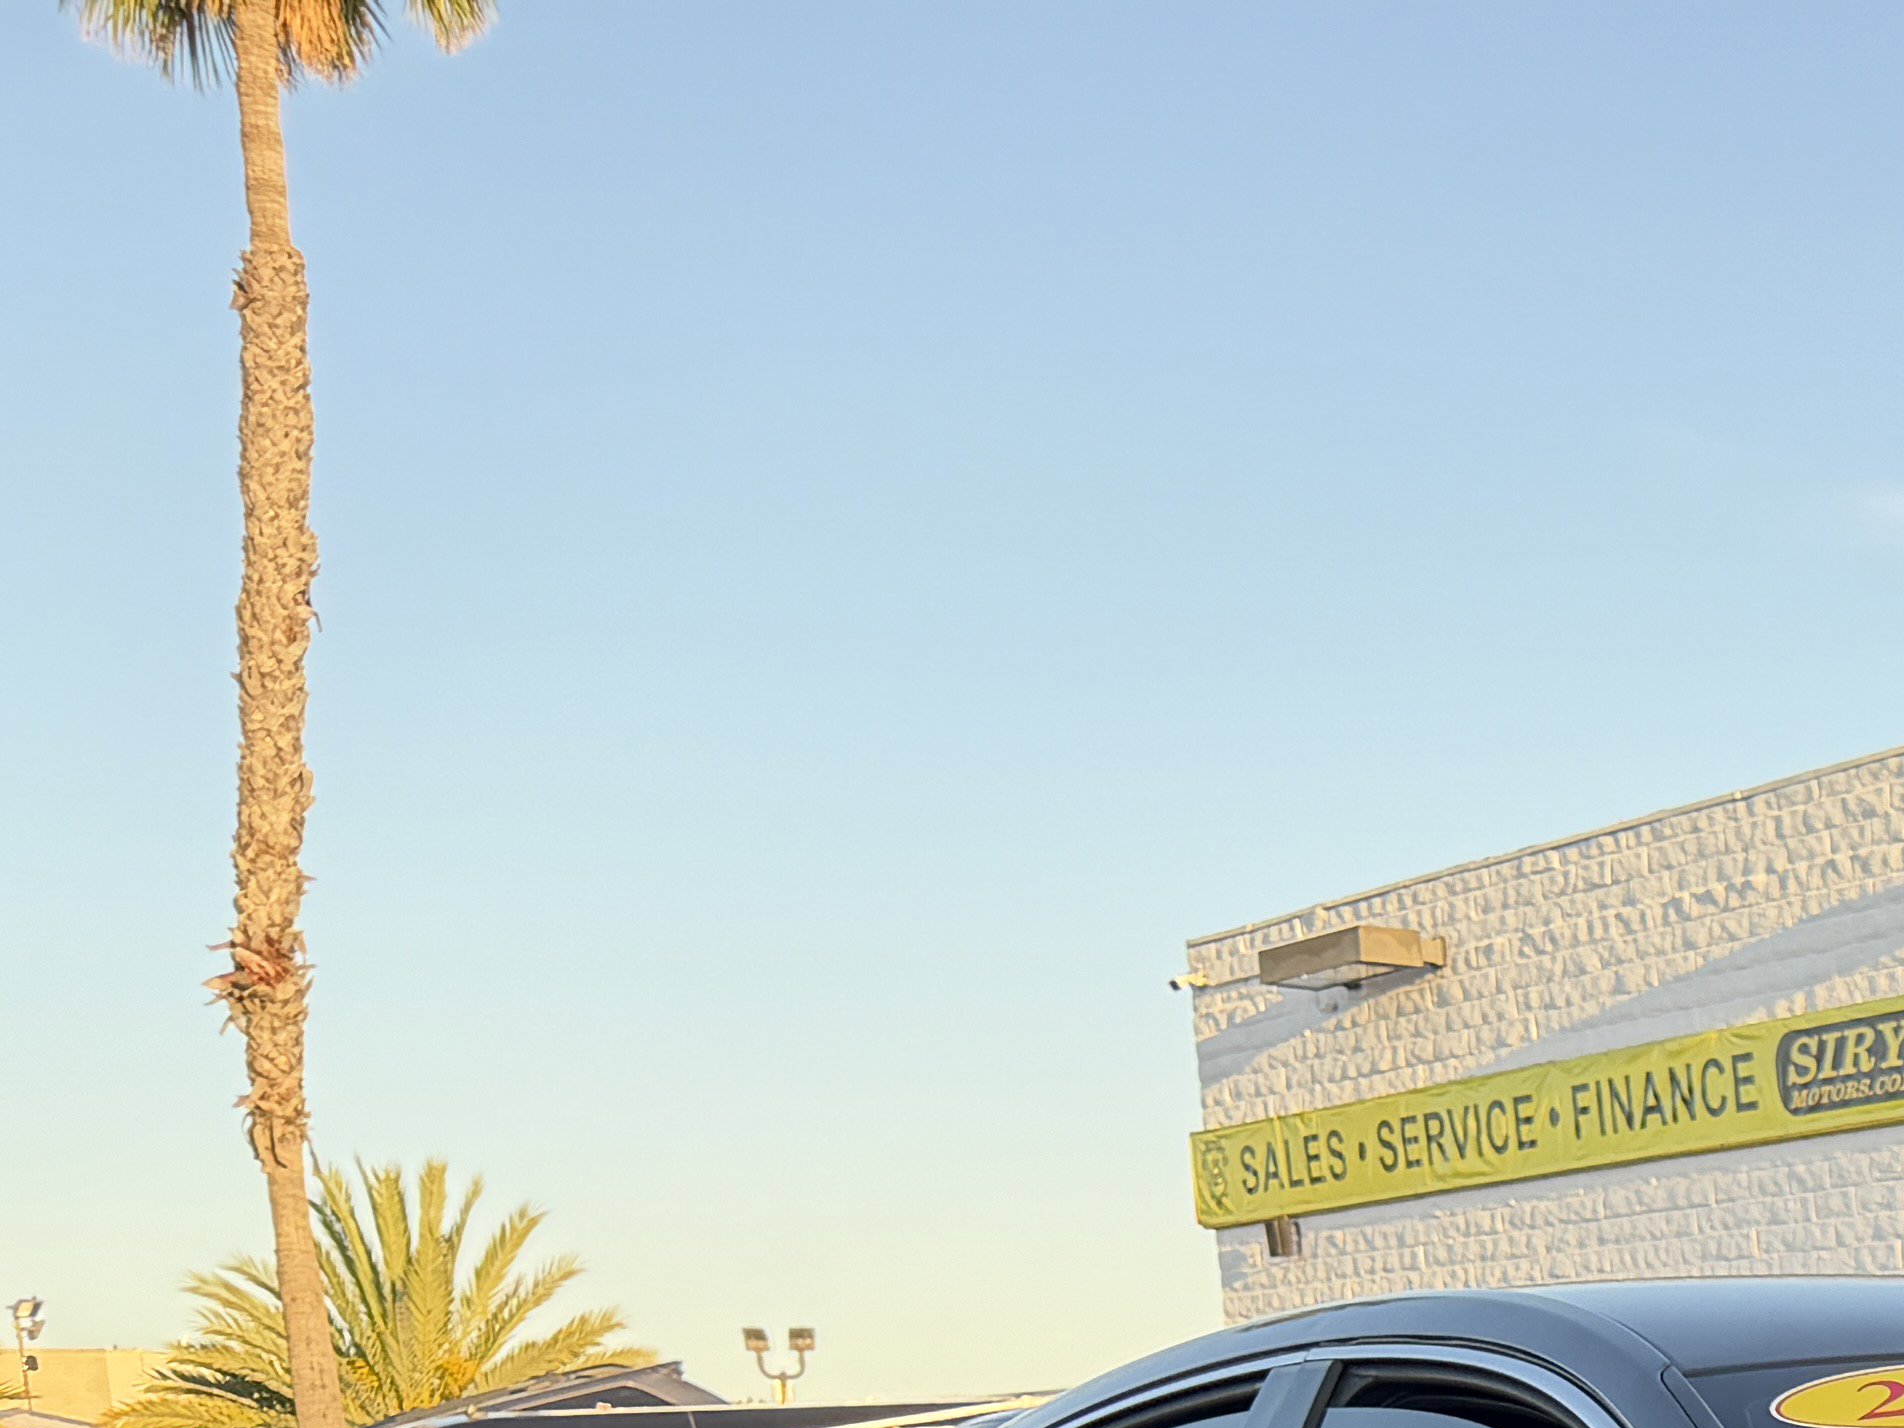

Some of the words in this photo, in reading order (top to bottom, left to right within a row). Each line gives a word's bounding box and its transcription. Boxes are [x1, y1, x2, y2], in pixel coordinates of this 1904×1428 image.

[1241, 1130, 1347, 1196] SALES
[1379, 1094, 1538, 1173] SERVICE
[1571, 1051, 1759, 1139] FINANCE
